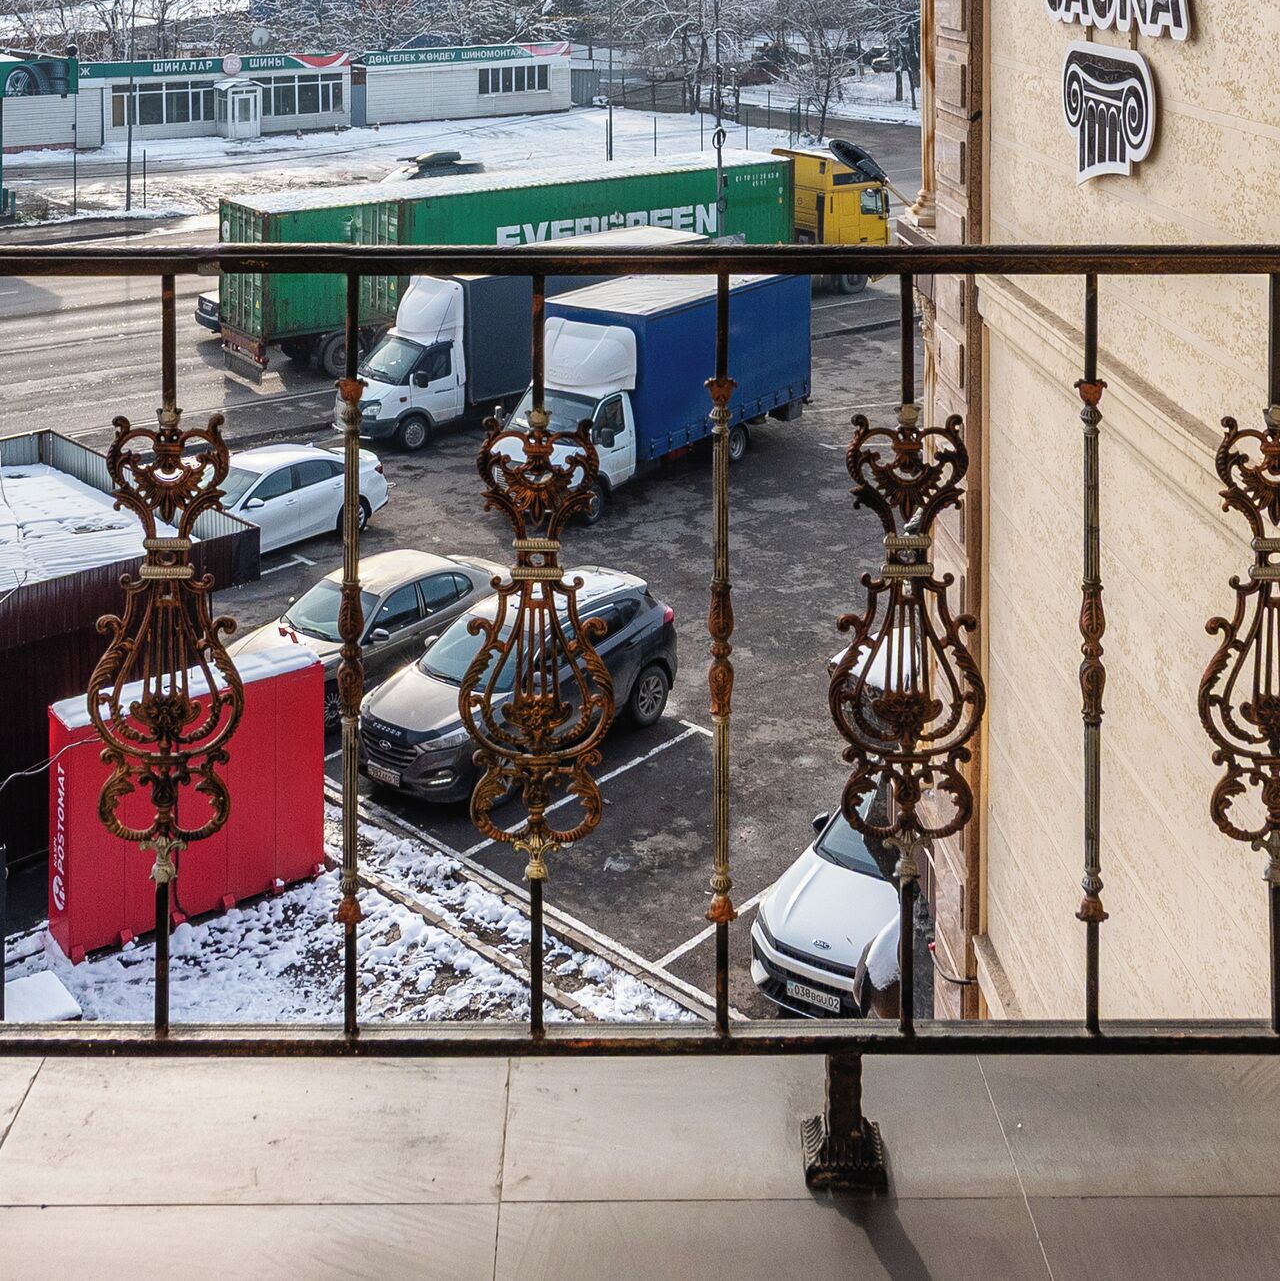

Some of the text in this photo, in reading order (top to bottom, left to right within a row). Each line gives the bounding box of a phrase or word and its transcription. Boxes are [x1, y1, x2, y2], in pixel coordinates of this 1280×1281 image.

[418, 51, 456, 62] ЖӨНДЕУ
[461, 47, 523, 59] ШИНОМОНТАЖ
[153, 61, 213, 73] ШИНАЛАР
[249, 57, 285, 68] ШИНЫ
[57, 762, 65, 876] POSTOMAT
